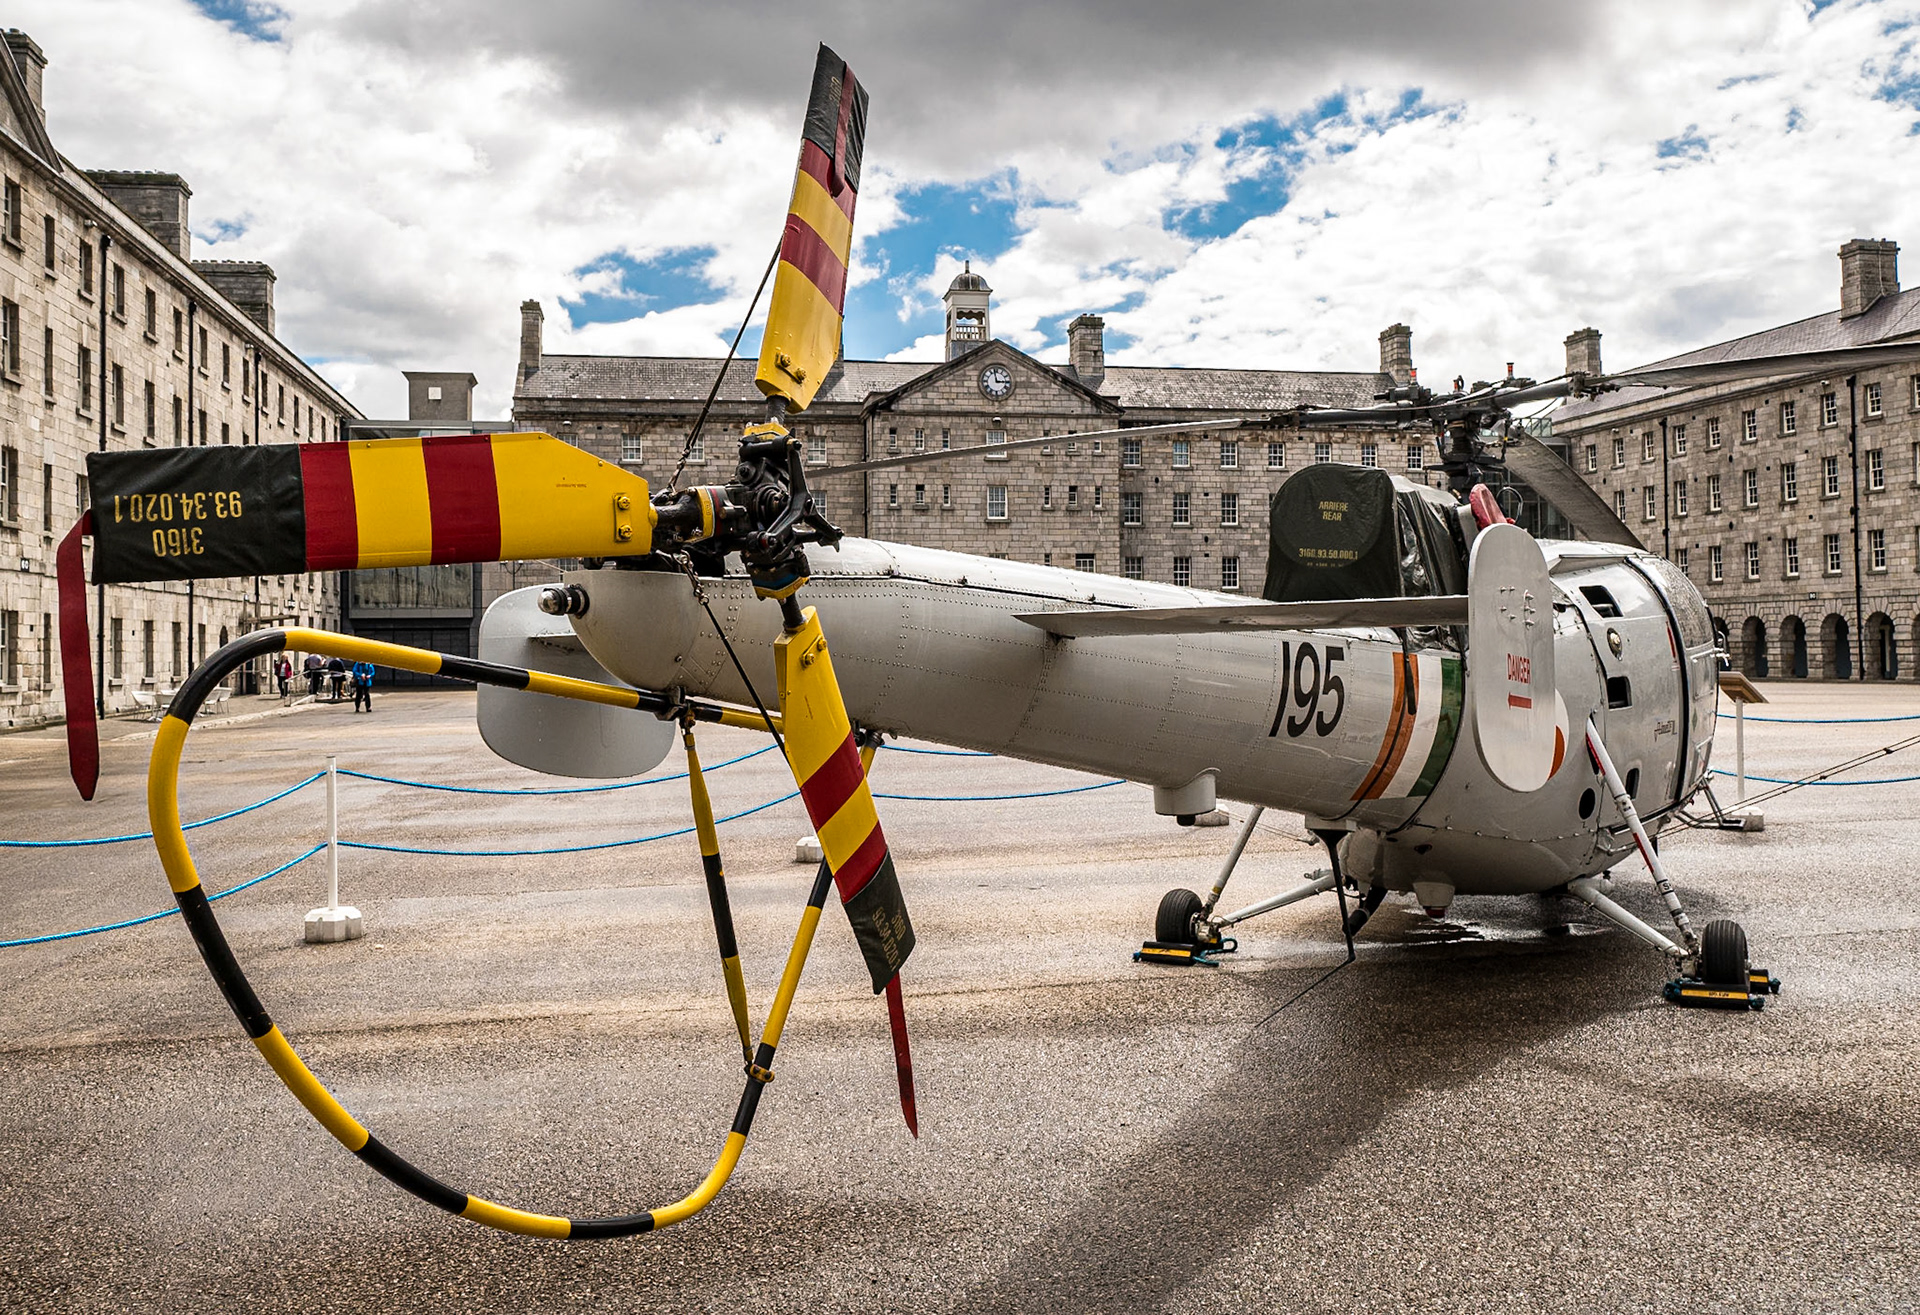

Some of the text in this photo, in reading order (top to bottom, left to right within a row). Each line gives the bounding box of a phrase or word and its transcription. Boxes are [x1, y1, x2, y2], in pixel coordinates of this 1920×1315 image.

[114, 490, 242, 523] 93.34.020.1
[1322, 511, 1342, 521] REAR
[152, 527, 204, 557] 3160
[1507, 653, 1531, 684] DANGER
[1268, 641, 1345, 738] 195
